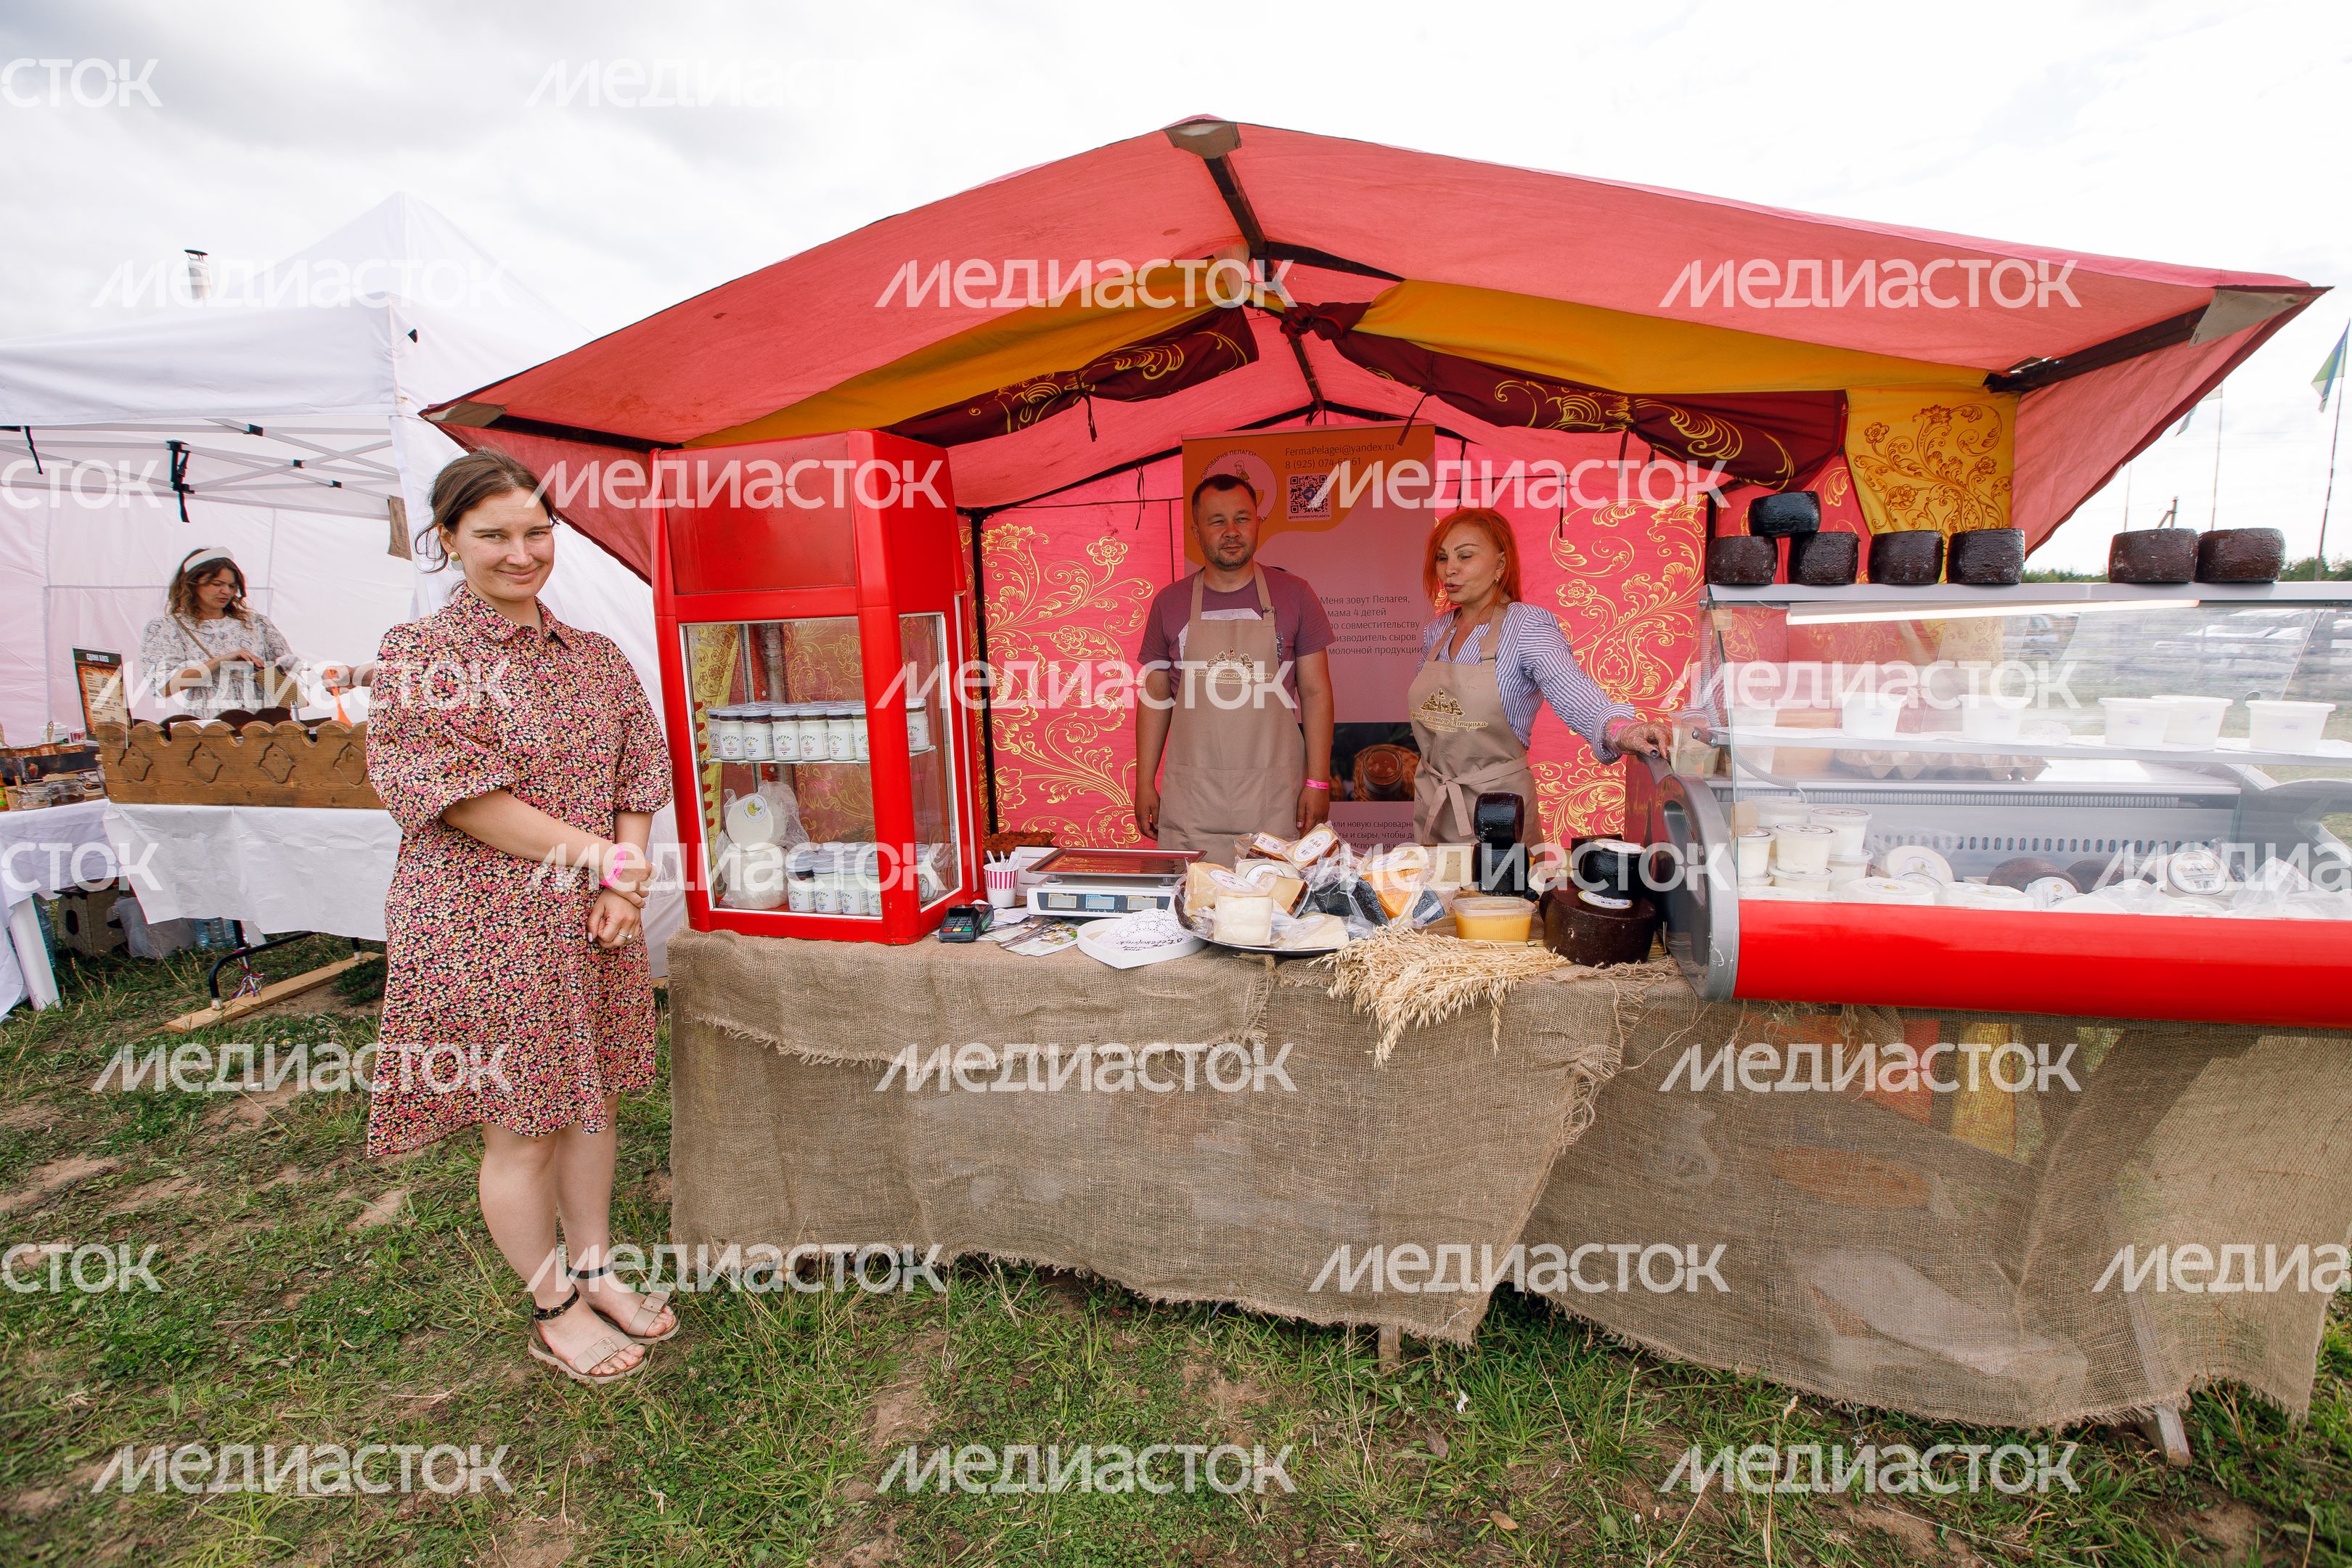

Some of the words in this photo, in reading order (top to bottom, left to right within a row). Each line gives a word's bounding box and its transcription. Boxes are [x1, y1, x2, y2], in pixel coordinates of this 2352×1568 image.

[1285, 443, 1395, 456] FermaPelagei@yandex.ru
[1294, 460, 1315, 470] (925)
[1346, 596, 1370, 607] зовут
[1373, 595, 1410, 604] Пелагея,
[1361, 608, 1387, 618] детей
[1341, 621, 1420, 630] совместительству
[1336, 634, 1387, 643] изводитель
[1389, 633, 1416, 643] сыров
[1328, 645, 1372, 656] молочной
